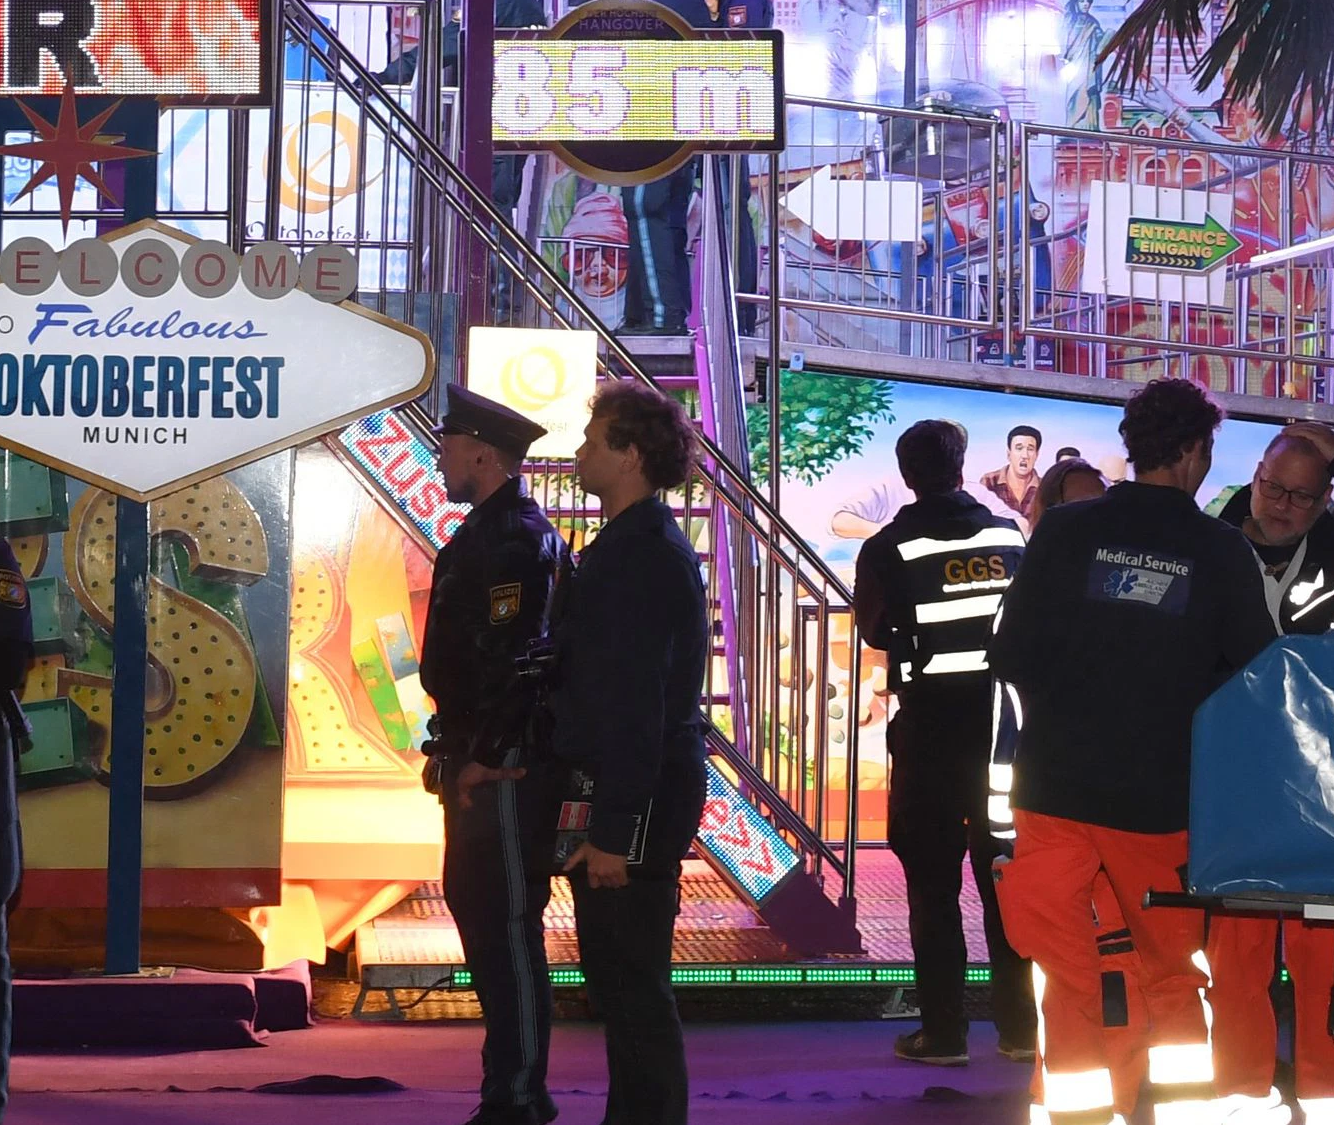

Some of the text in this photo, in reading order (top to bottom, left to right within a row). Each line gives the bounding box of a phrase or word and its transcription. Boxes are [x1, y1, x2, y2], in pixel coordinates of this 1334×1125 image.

[579, 18, 665, 30] HANGOVER
[493, 45, 774, 136] 85 m
[1128, 223, 1228, 246] ENTRANCE
[1139, 241, 1213, 259] EINGANG
[27, 303, 269, 345] Fabulous
[82, 427, 189, 446] MUNICH
[944, 554, 1008, 583] GGS
[1095, 548, 1190, 576] Medical Service
